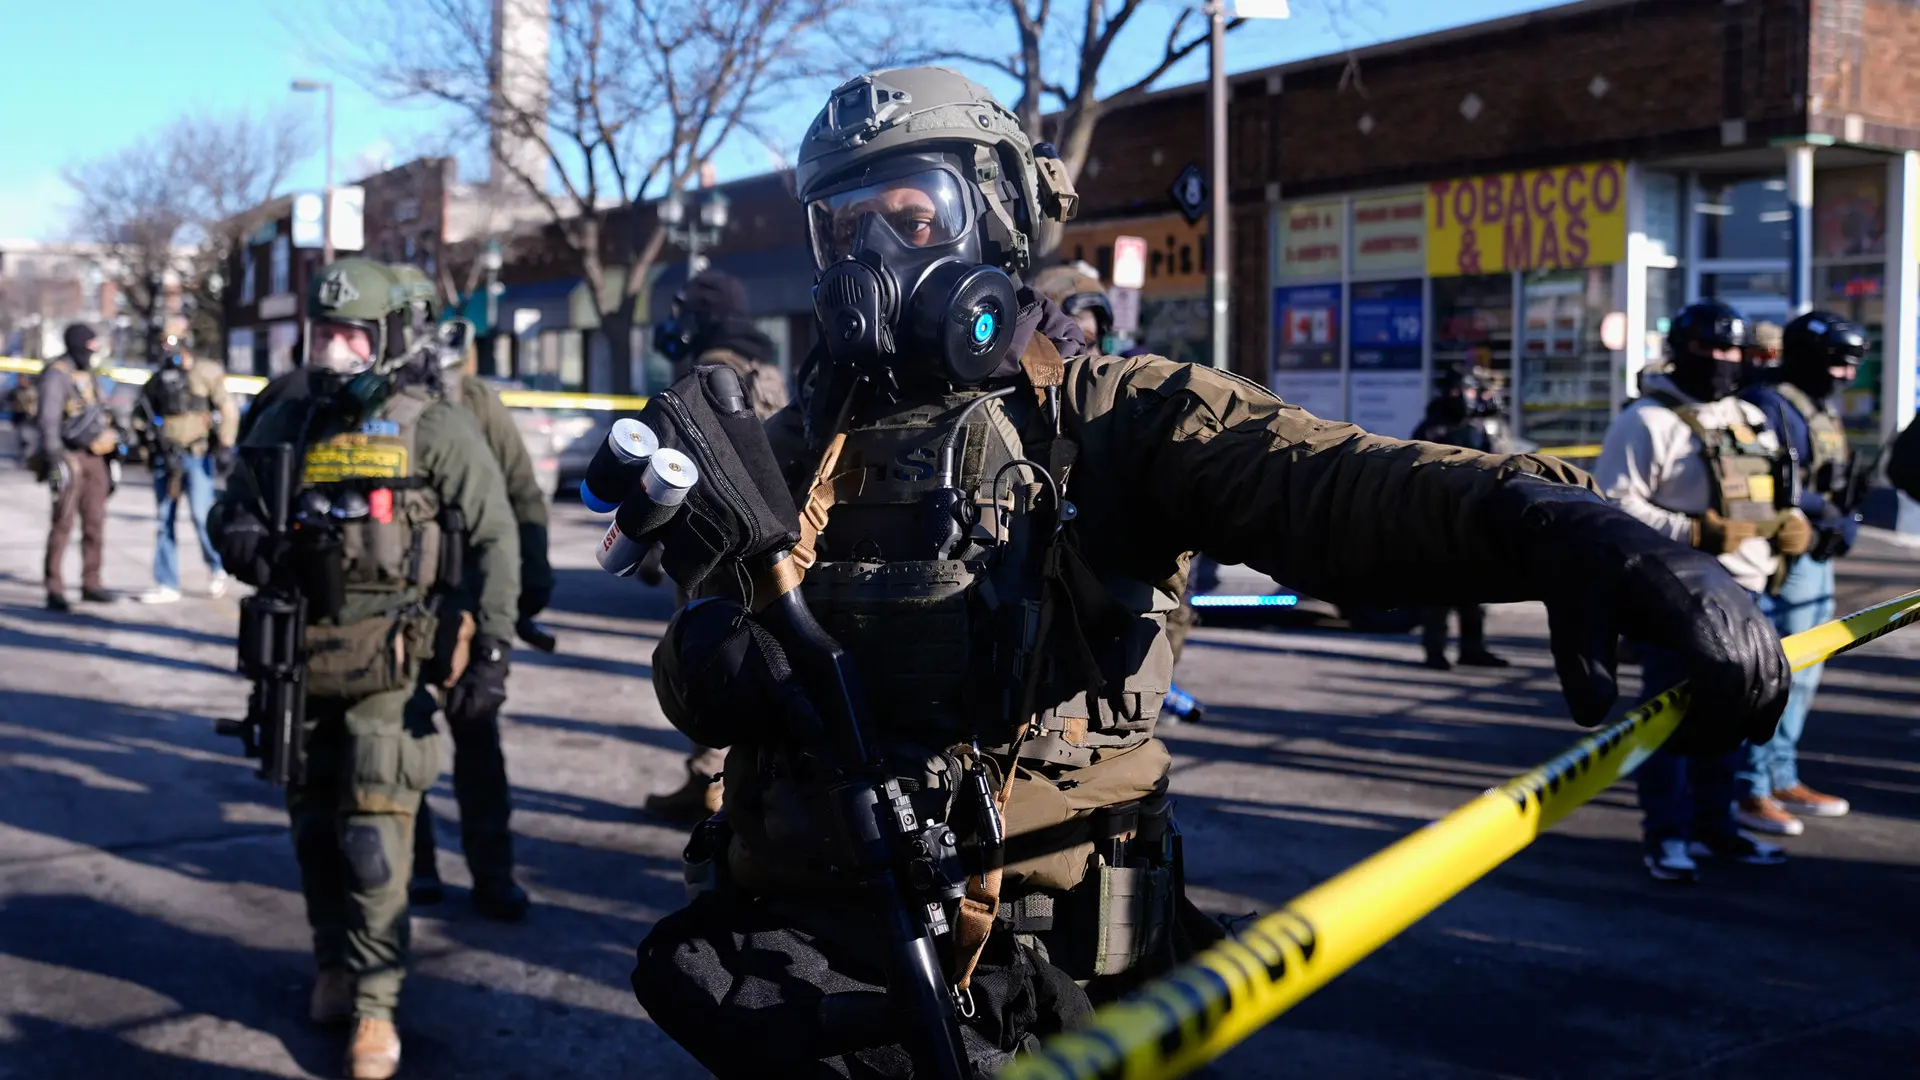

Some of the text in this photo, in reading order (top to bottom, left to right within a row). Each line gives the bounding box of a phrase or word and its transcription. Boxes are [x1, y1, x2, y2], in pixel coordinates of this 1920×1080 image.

[1430, 162, 1621, 228] TOBACCO
[1457, 225, 1482, 273] &
[1504, 215, 1589, 270] MAS
